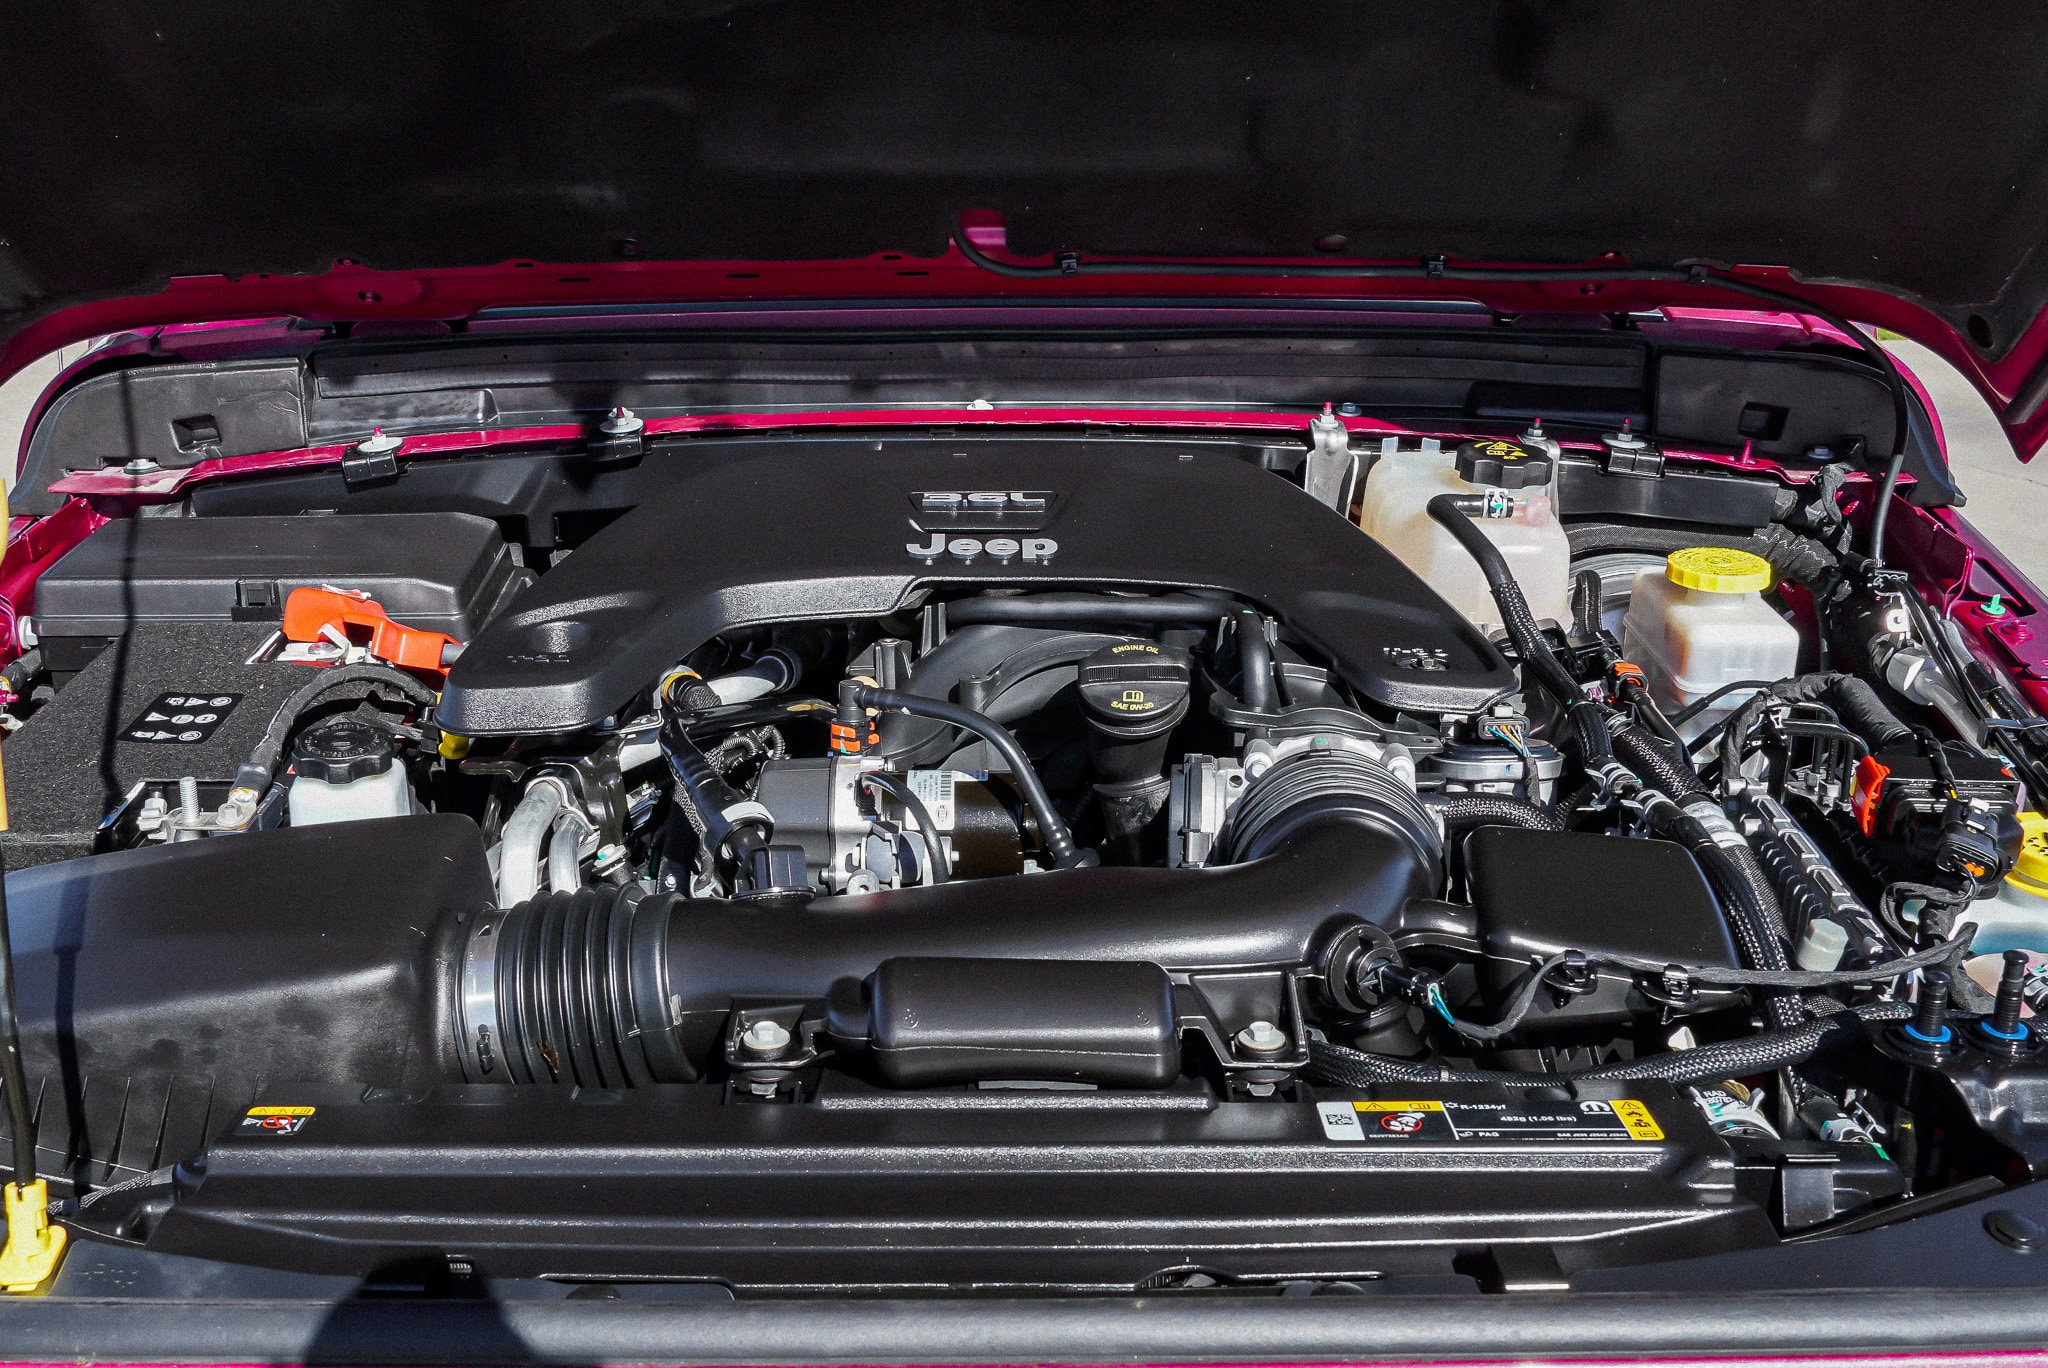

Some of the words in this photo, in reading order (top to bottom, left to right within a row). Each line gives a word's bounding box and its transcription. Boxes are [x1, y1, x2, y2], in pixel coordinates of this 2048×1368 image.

[905, 533, 1058, 563] Jeep
[1112, 645, 1145, 653] ENGINE
[1146, 646, 1159, 654] OIL
[1111, 701, 1128, 710] SAE
[1130, 702, 1154, 710] 0W-20
